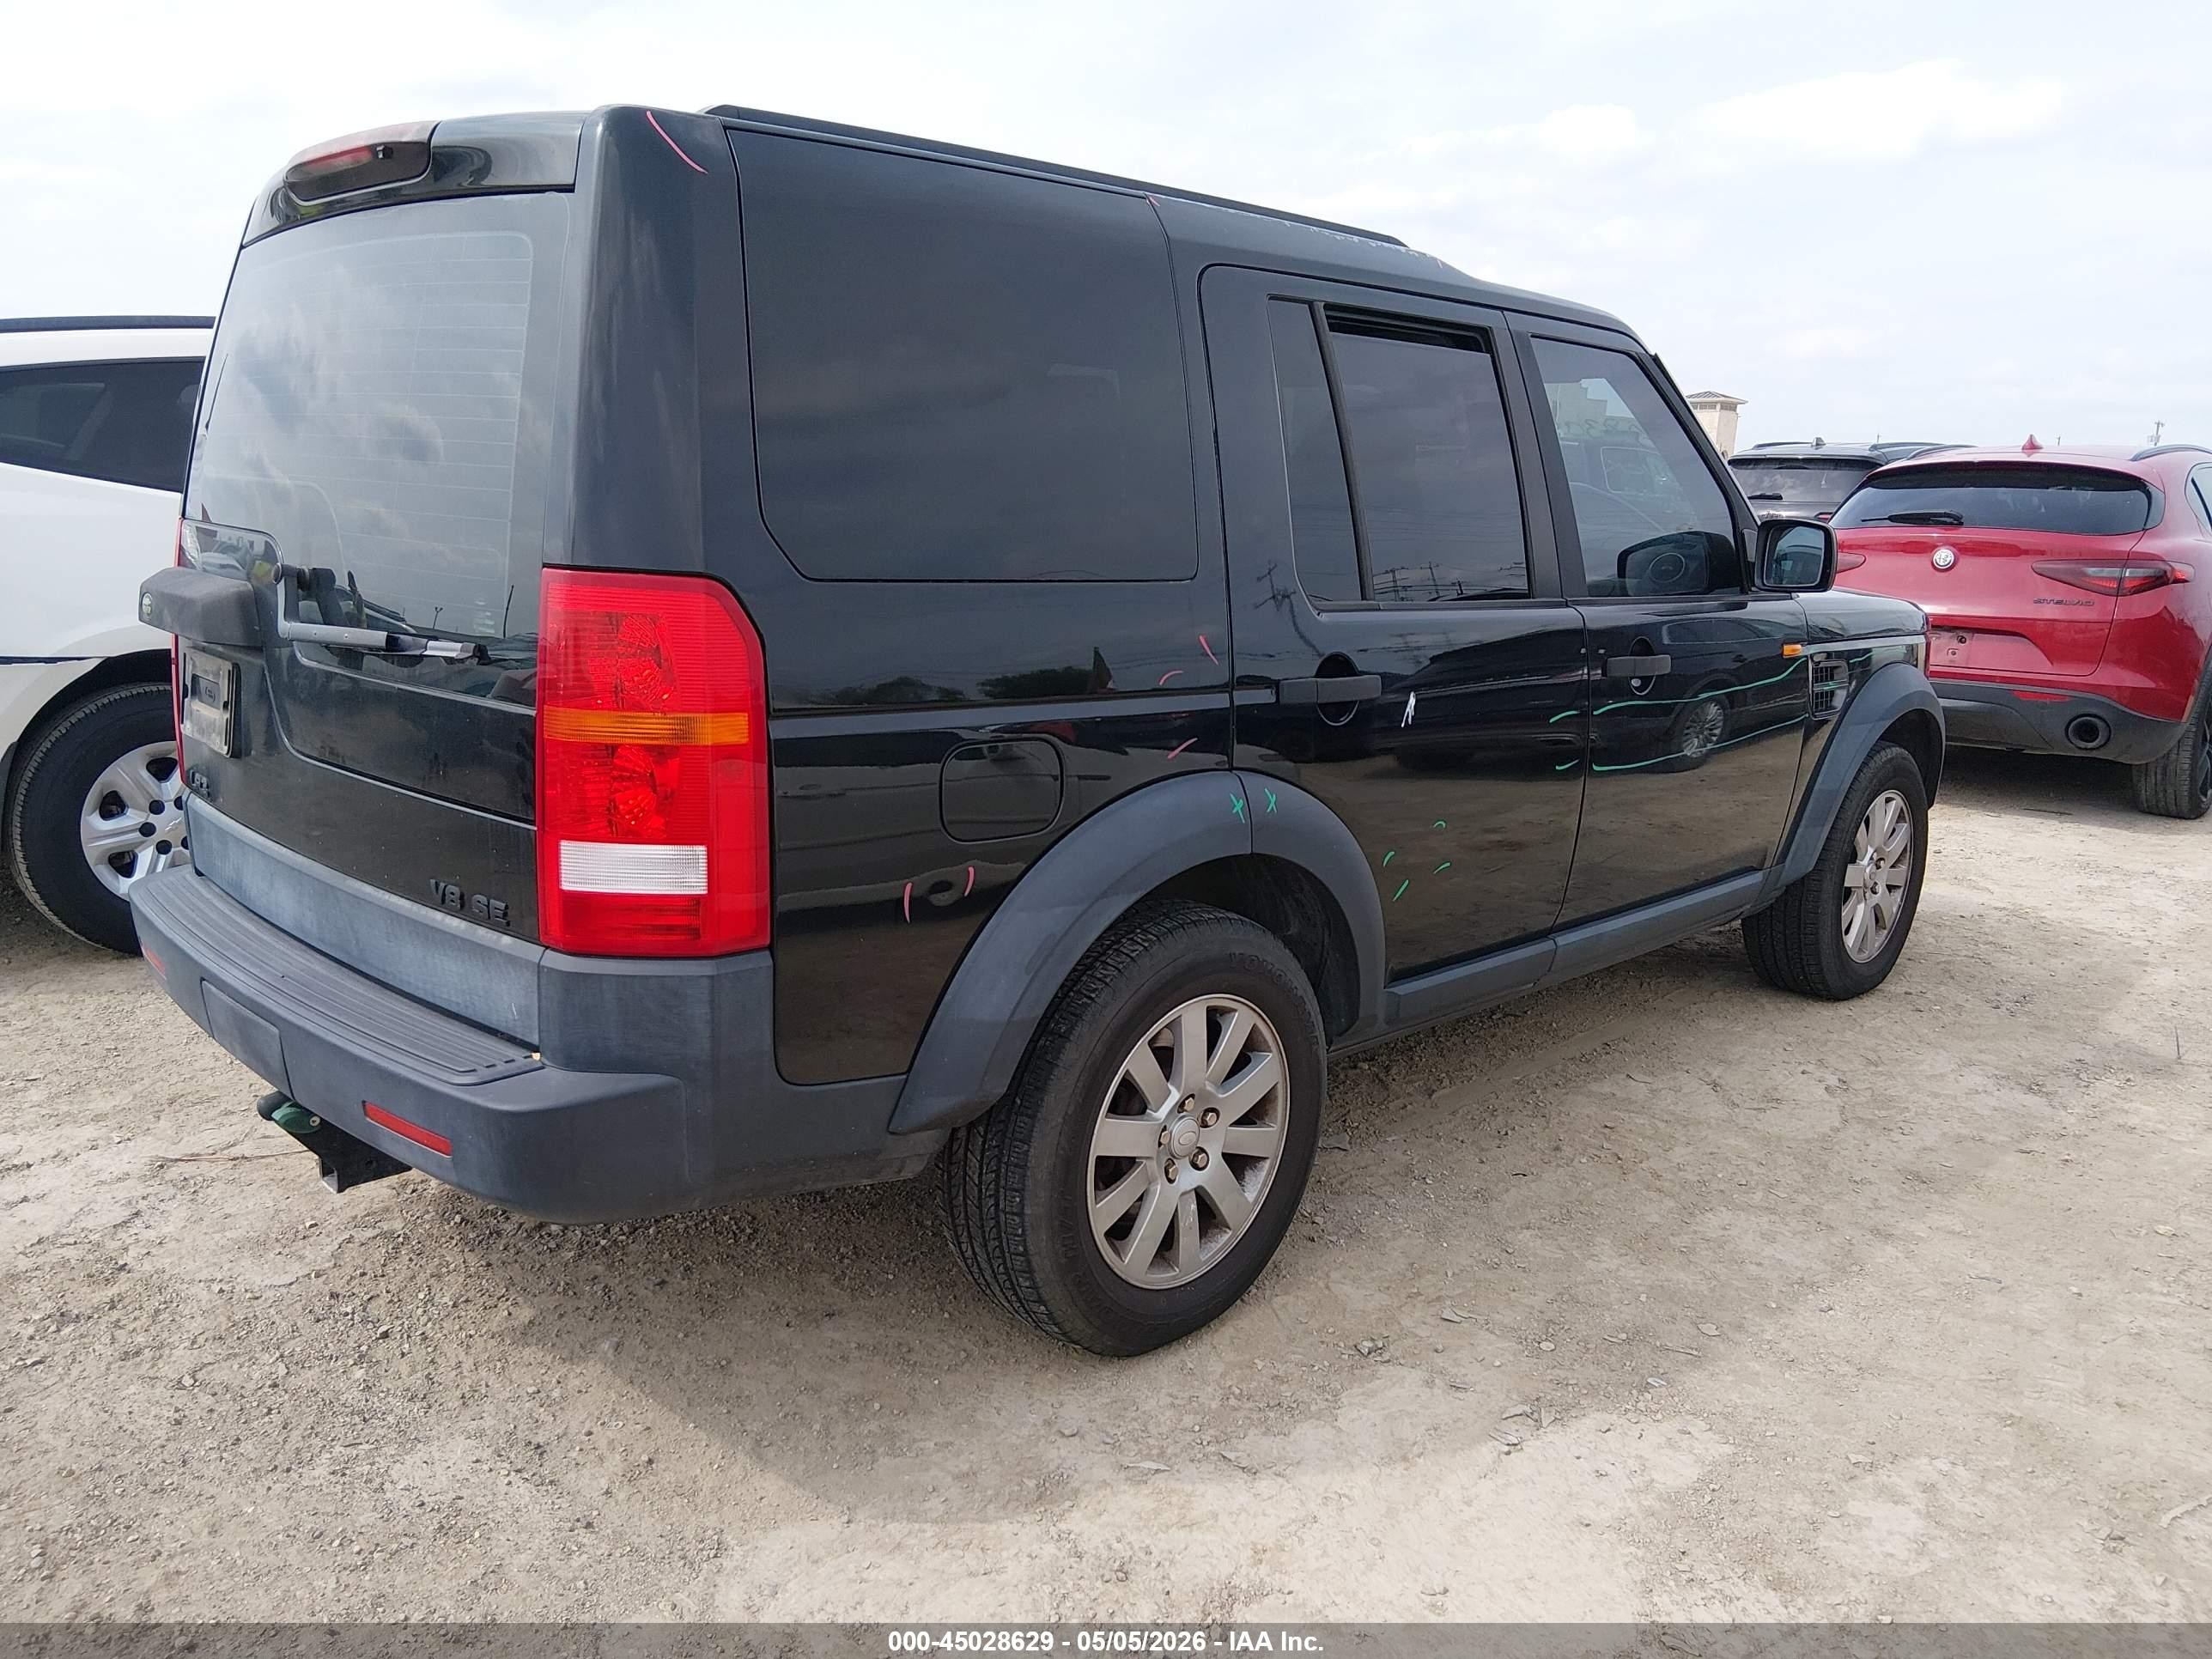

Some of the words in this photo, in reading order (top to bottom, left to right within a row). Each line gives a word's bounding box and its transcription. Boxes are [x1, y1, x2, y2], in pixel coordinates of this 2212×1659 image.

[2033, 598, 2095, 606] STELVIO
[428, 878, 464, 912] V8
[471, 893, 509, 926] SE
